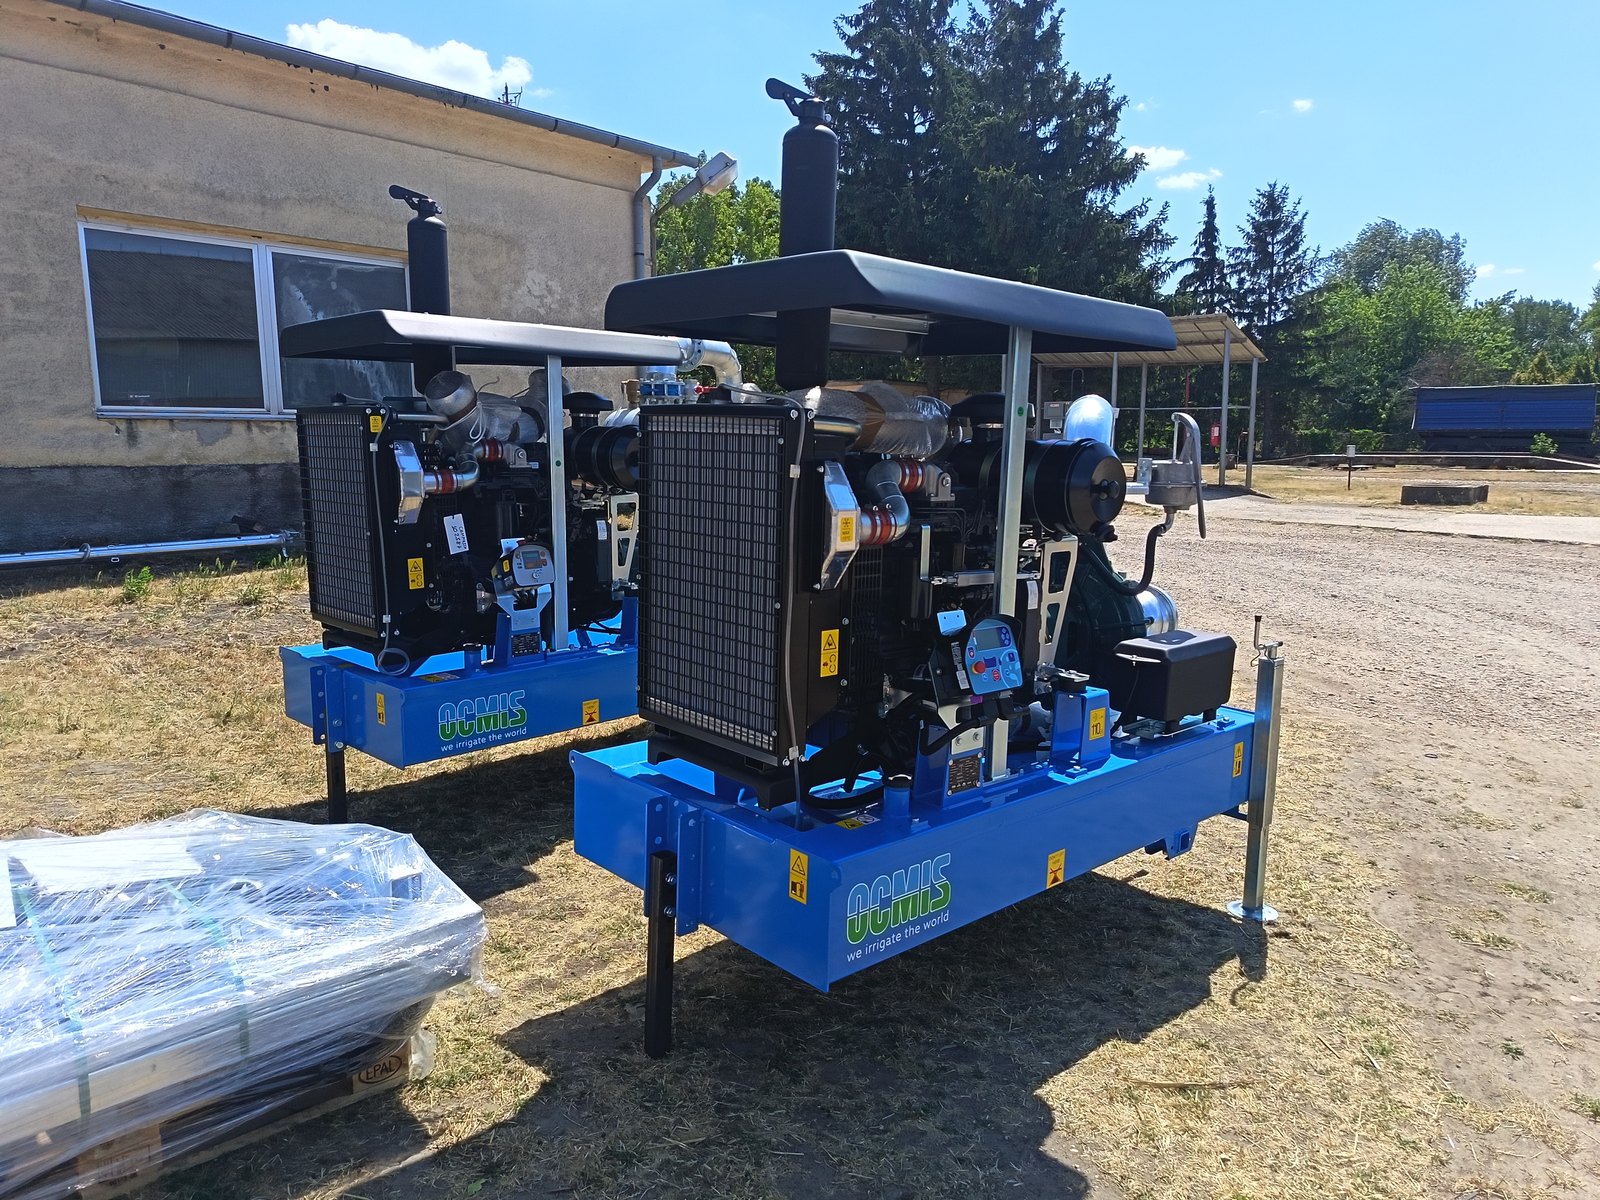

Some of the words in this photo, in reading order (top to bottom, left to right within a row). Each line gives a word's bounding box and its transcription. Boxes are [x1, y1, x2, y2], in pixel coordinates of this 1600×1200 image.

[438, 690, 527, 741] OCMIS
[441, 744, 454, 752] we
[456, 737, 487, 748] irrigate
[488, 733, 502, 741] the
[504, 727, 527, 738] world
[846, 853, 951, 945] OCMIS
[846, 949, 862, 962] we
[865, 932, 902, 954] irrigate
[904, 923, 921, 938] the
[923, 909, 950, 930] world
[366, 1060, 395, 1080] EPAL
